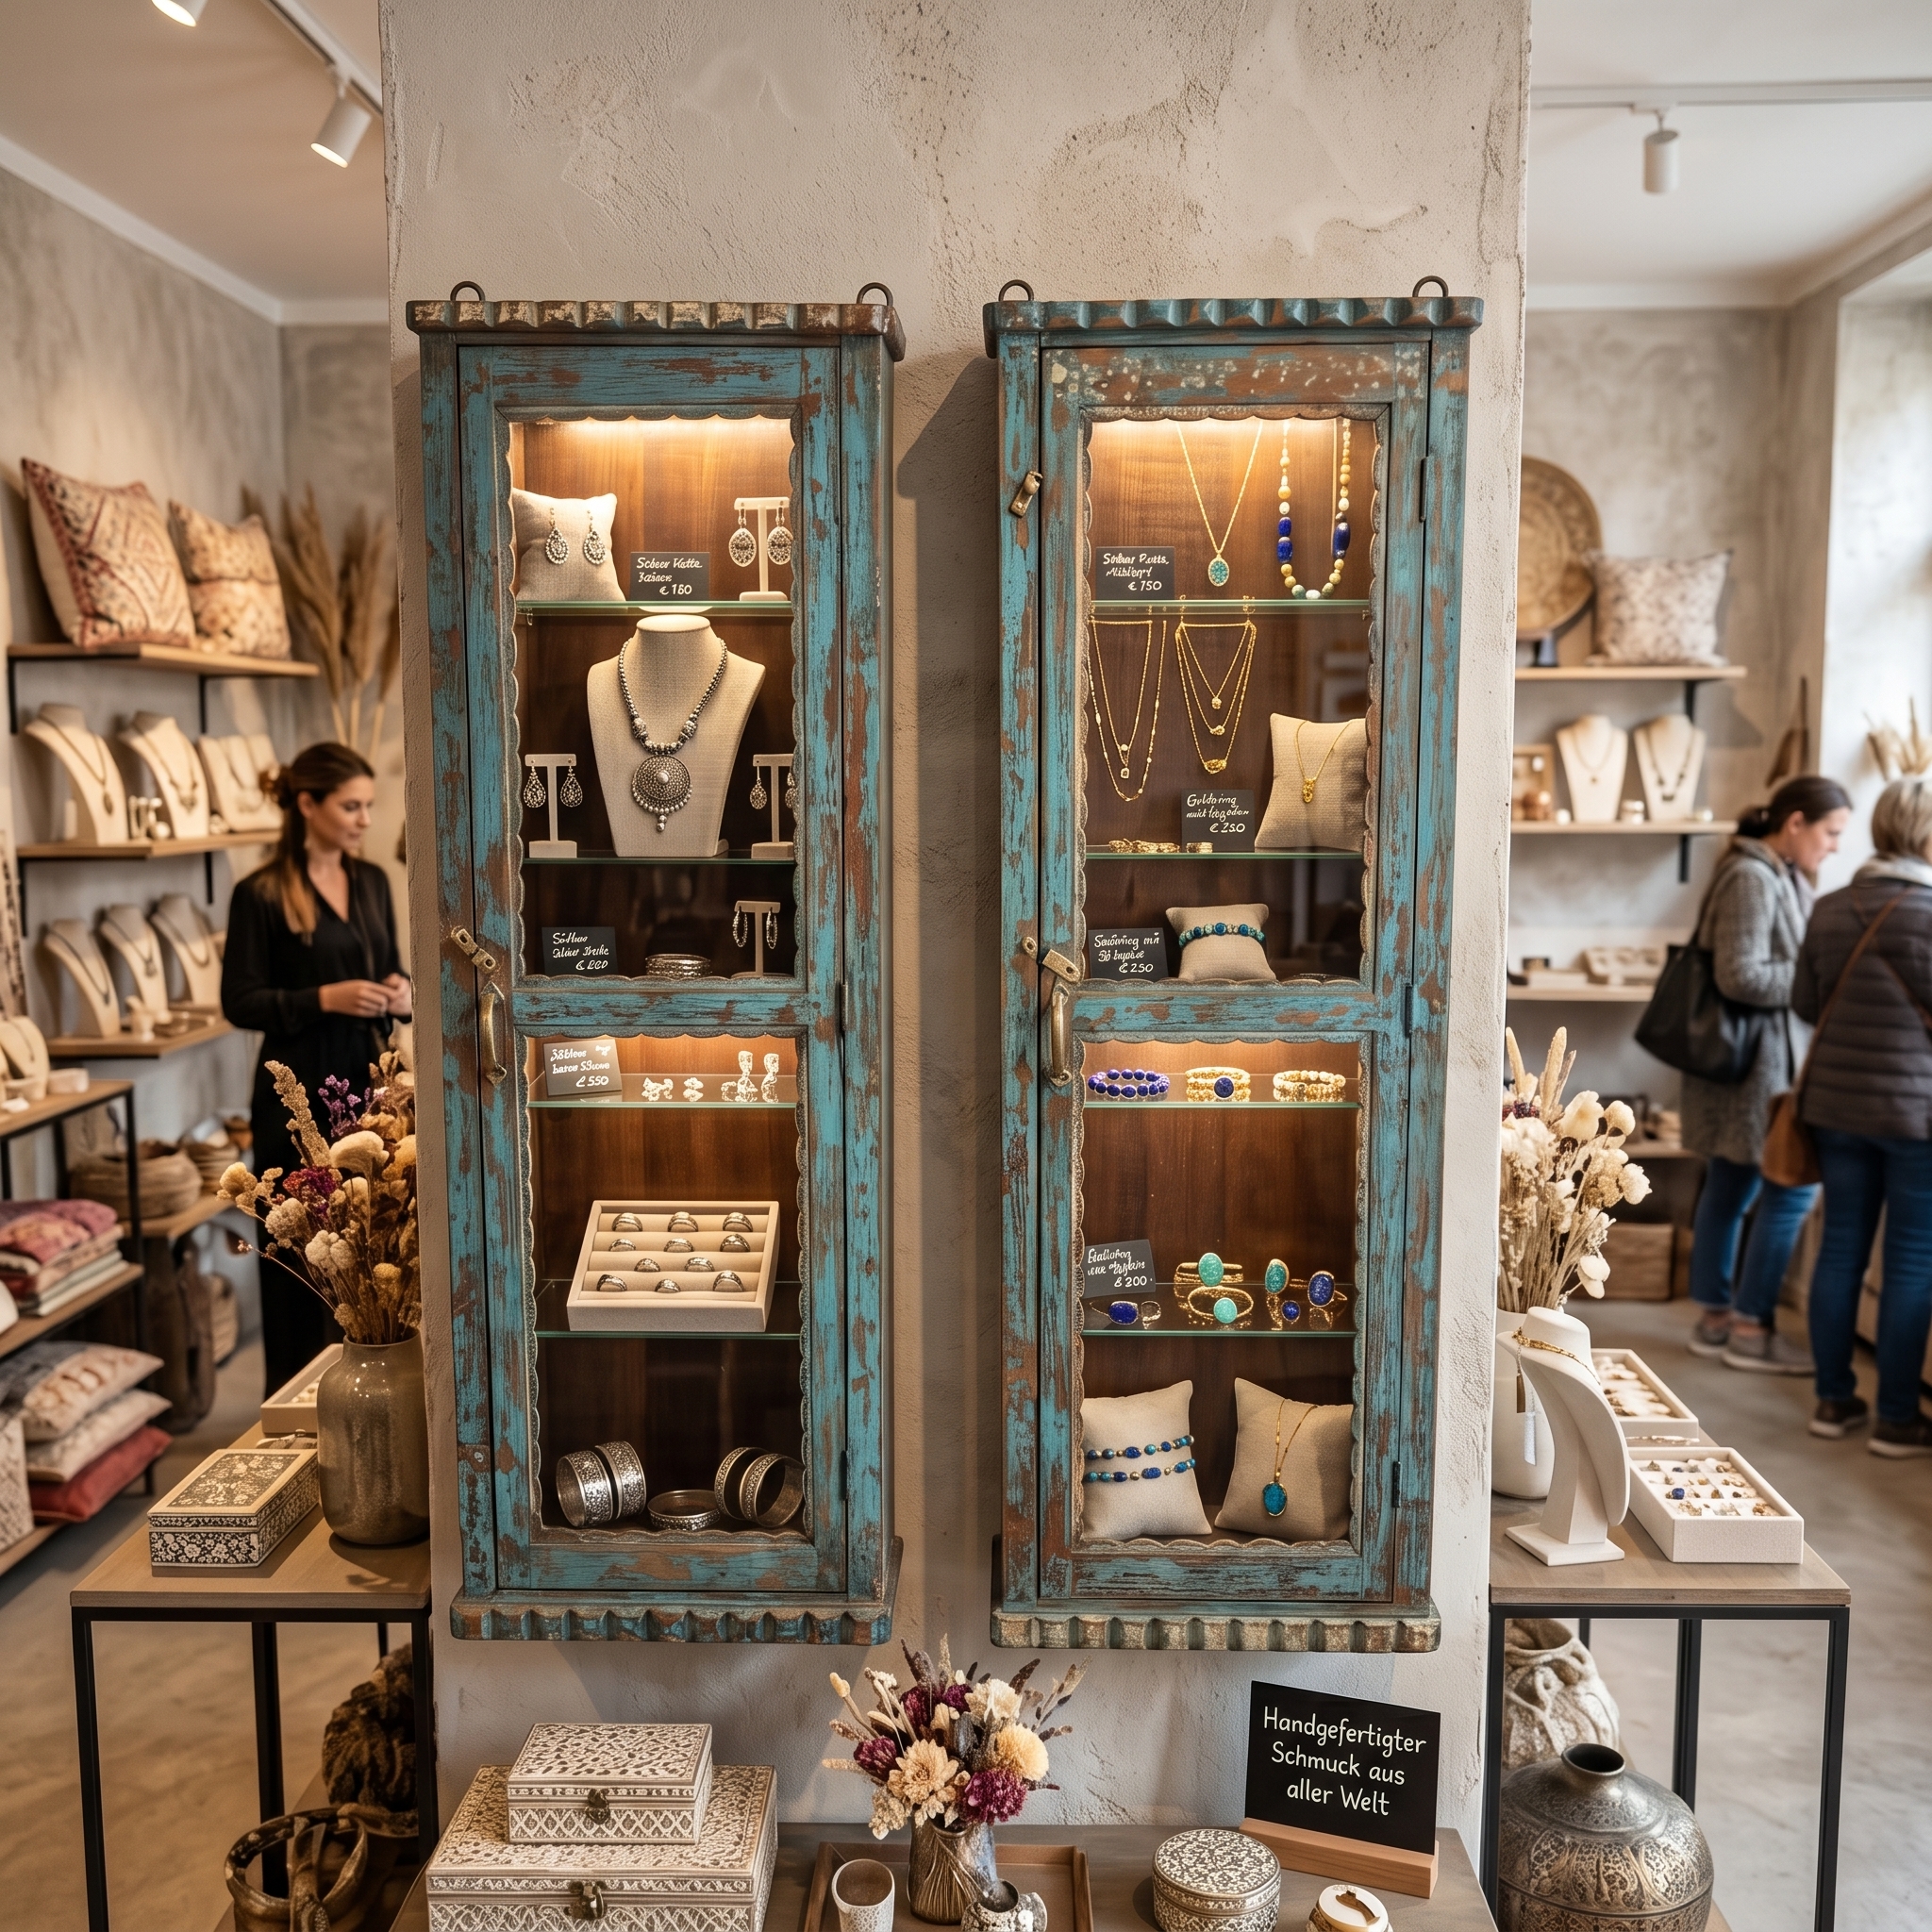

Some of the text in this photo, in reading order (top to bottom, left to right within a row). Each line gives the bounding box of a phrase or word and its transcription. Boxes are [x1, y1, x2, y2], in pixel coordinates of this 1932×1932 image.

[1130, 963, 1154, 974] 250
[1263, 1706, 1427, 1758] Handgefertigter
[1271, 1740, 1406, 1786] Schmuck aus
[1287, 1777, 1391, 1816] aller Welt
